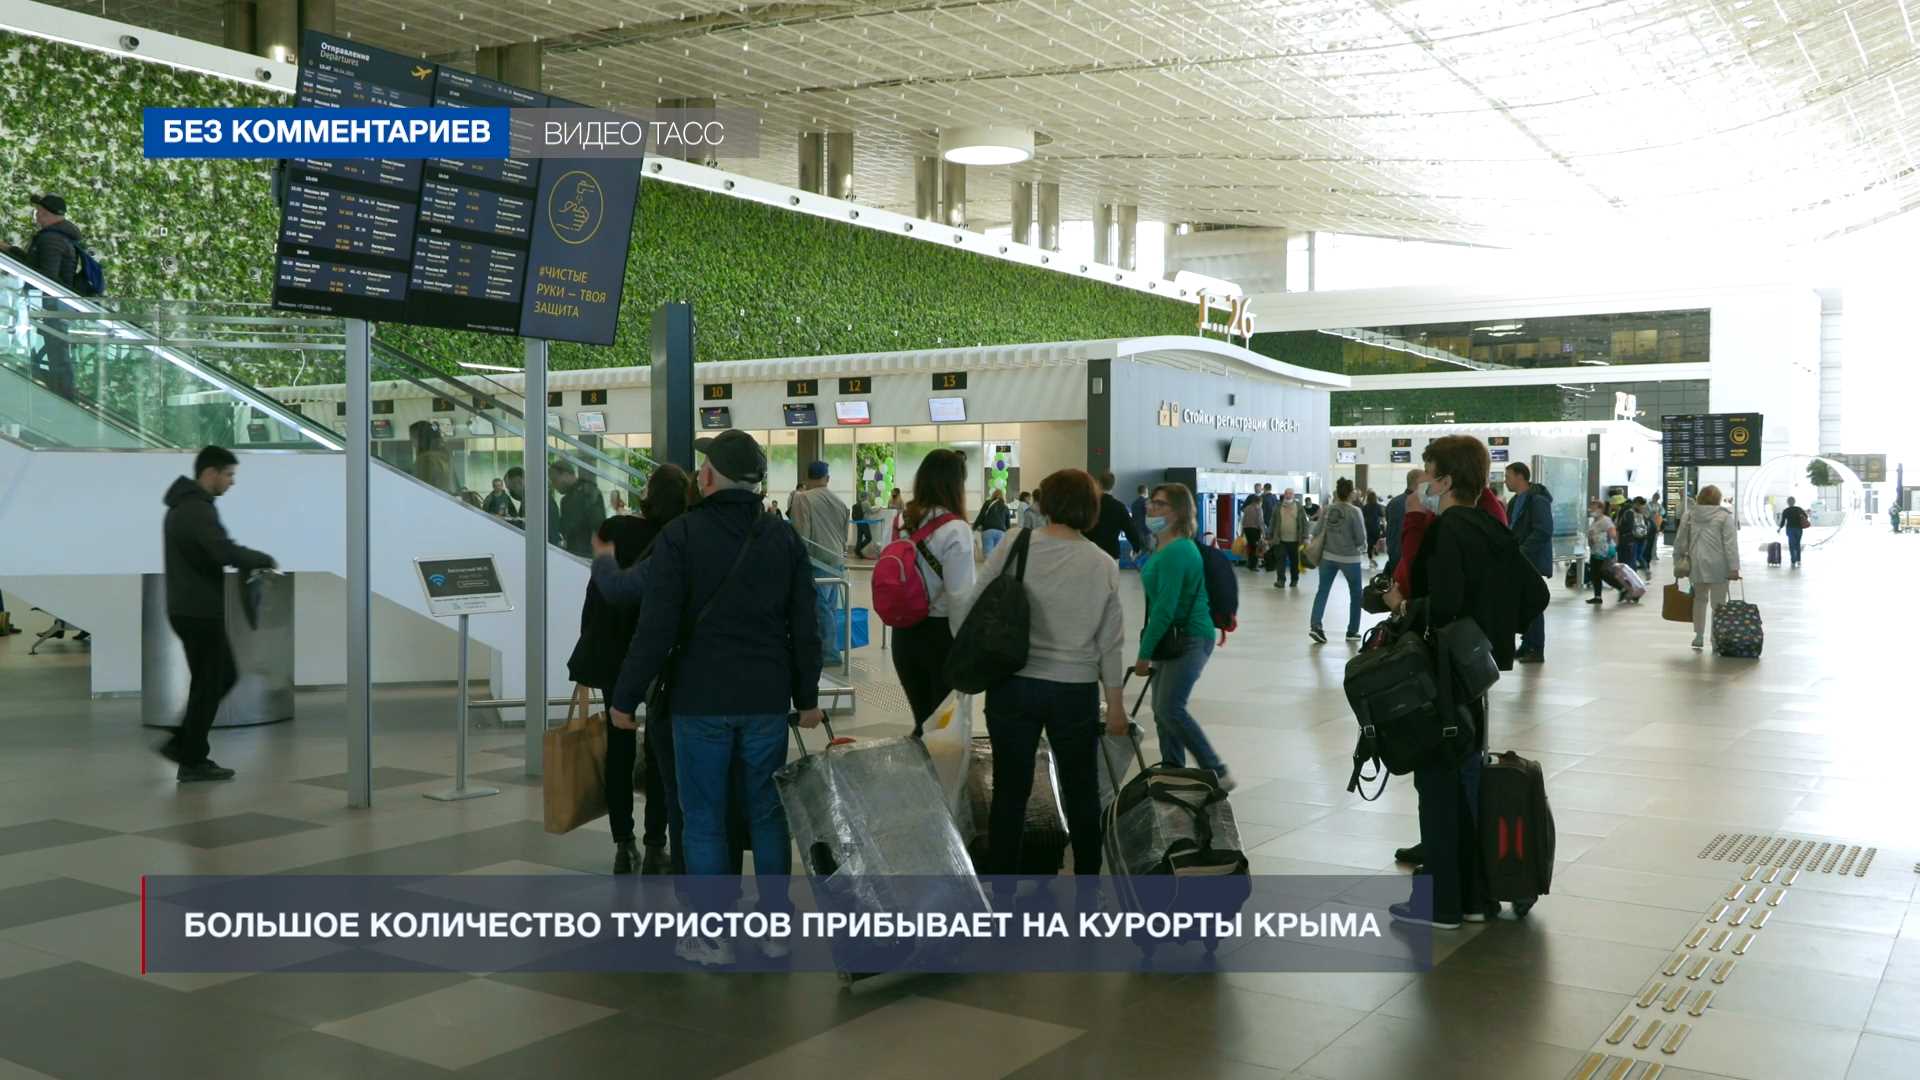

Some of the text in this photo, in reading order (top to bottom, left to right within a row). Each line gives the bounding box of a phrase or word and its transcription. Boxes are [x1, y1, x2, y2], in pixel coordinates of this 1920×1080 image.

[539, 266, 589, 283] #ЧИСТЫЕ
[536, 282, 565, 297] РУКИ
[580, 288, 607, 304] ТВОЯ
[533, 300, 581, 318] ЗАЩИТА
[796, 382, 808, 394] 11
[848, 379, 861, 392] 12
[944, 374, 957, 388] 13
[711, 387, 724, 398] 10
[1183, 407, 1268, 433] Стойки регистрации
